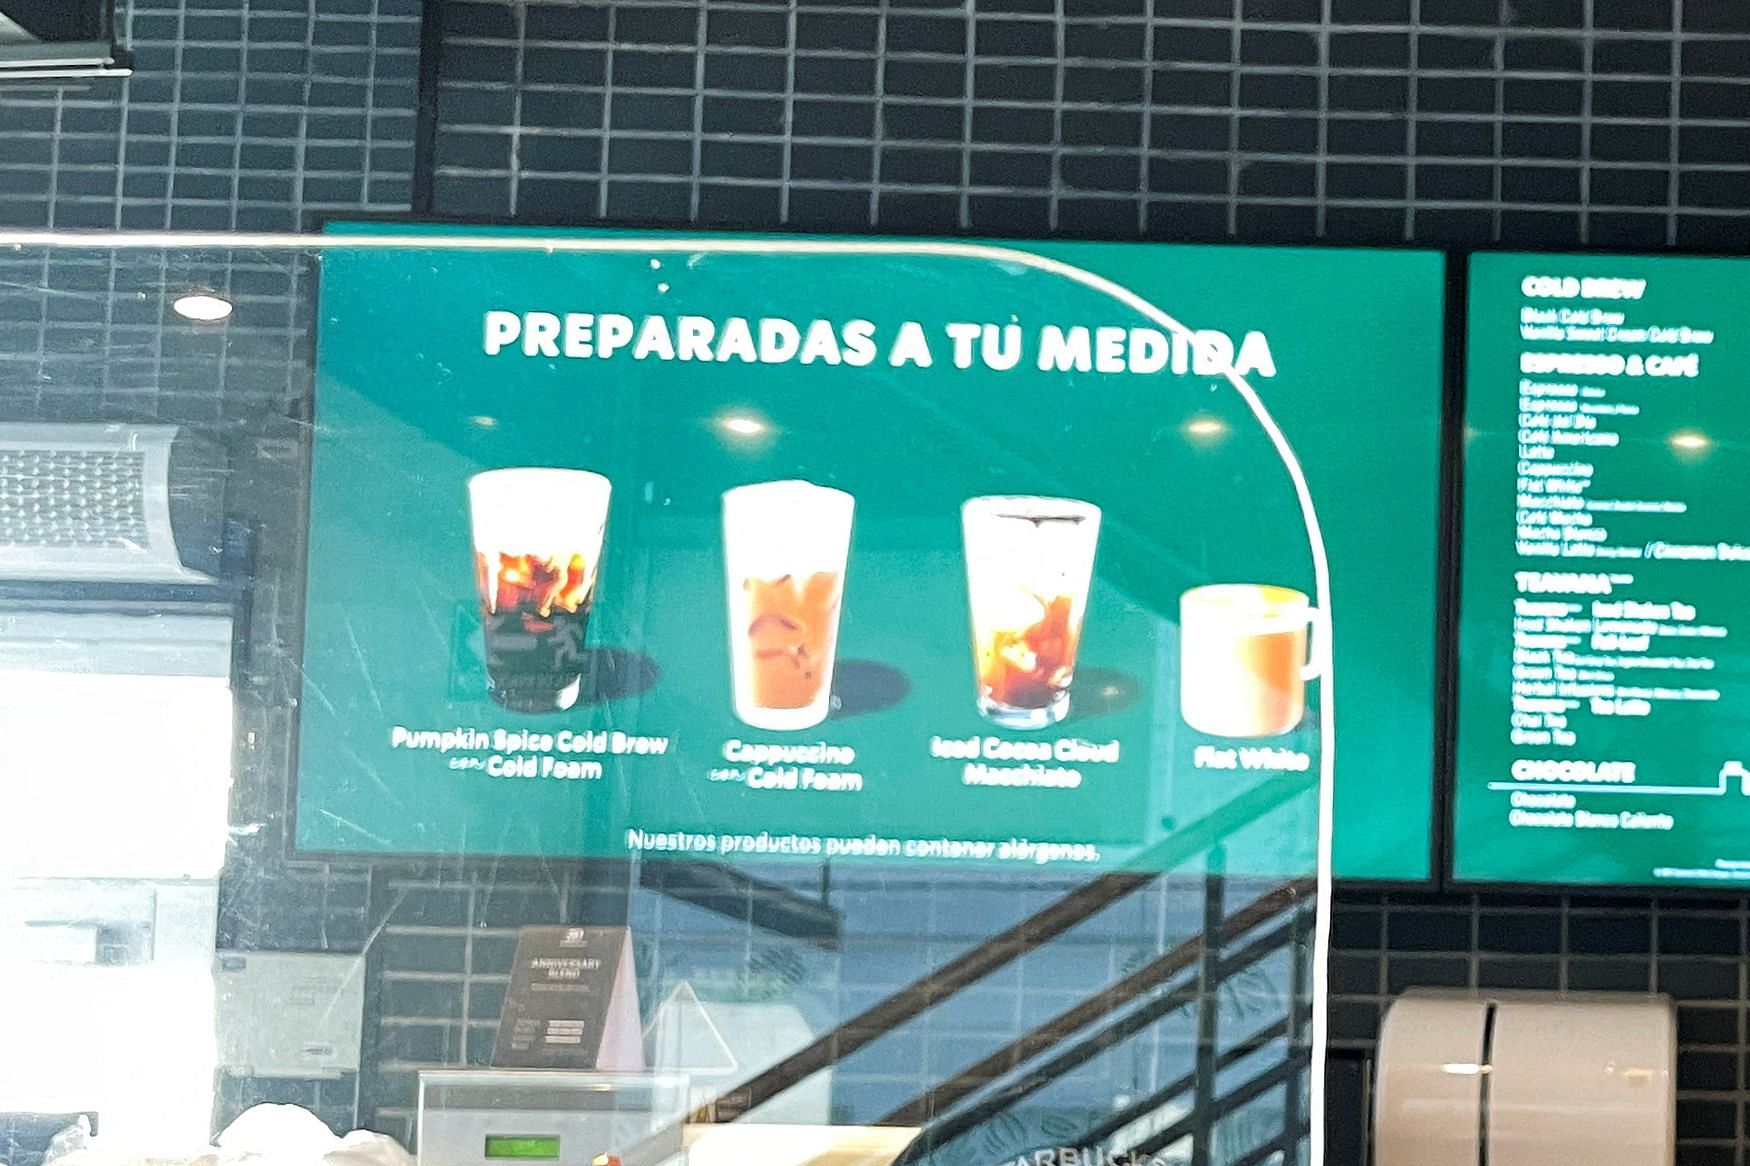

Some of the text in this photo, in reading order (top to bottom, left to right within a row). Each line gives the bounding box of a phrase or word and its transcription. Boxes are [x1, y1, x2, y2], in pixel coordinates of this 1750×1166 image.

[483, 310, 1277, 377] PREPARADAS A TU MEDIDA
[392, 726, 669, 754] Pumpkin Spice Cold Brew
[488, 756, 538, 778] Cold
[542, 756, 603, 779] Foam
[747, 767, 798, 790] Cold
[802, 768, 863, 791] Foam
[627, 830, 717, 852] Nuestros
[719, 832, 821, 855] productos
